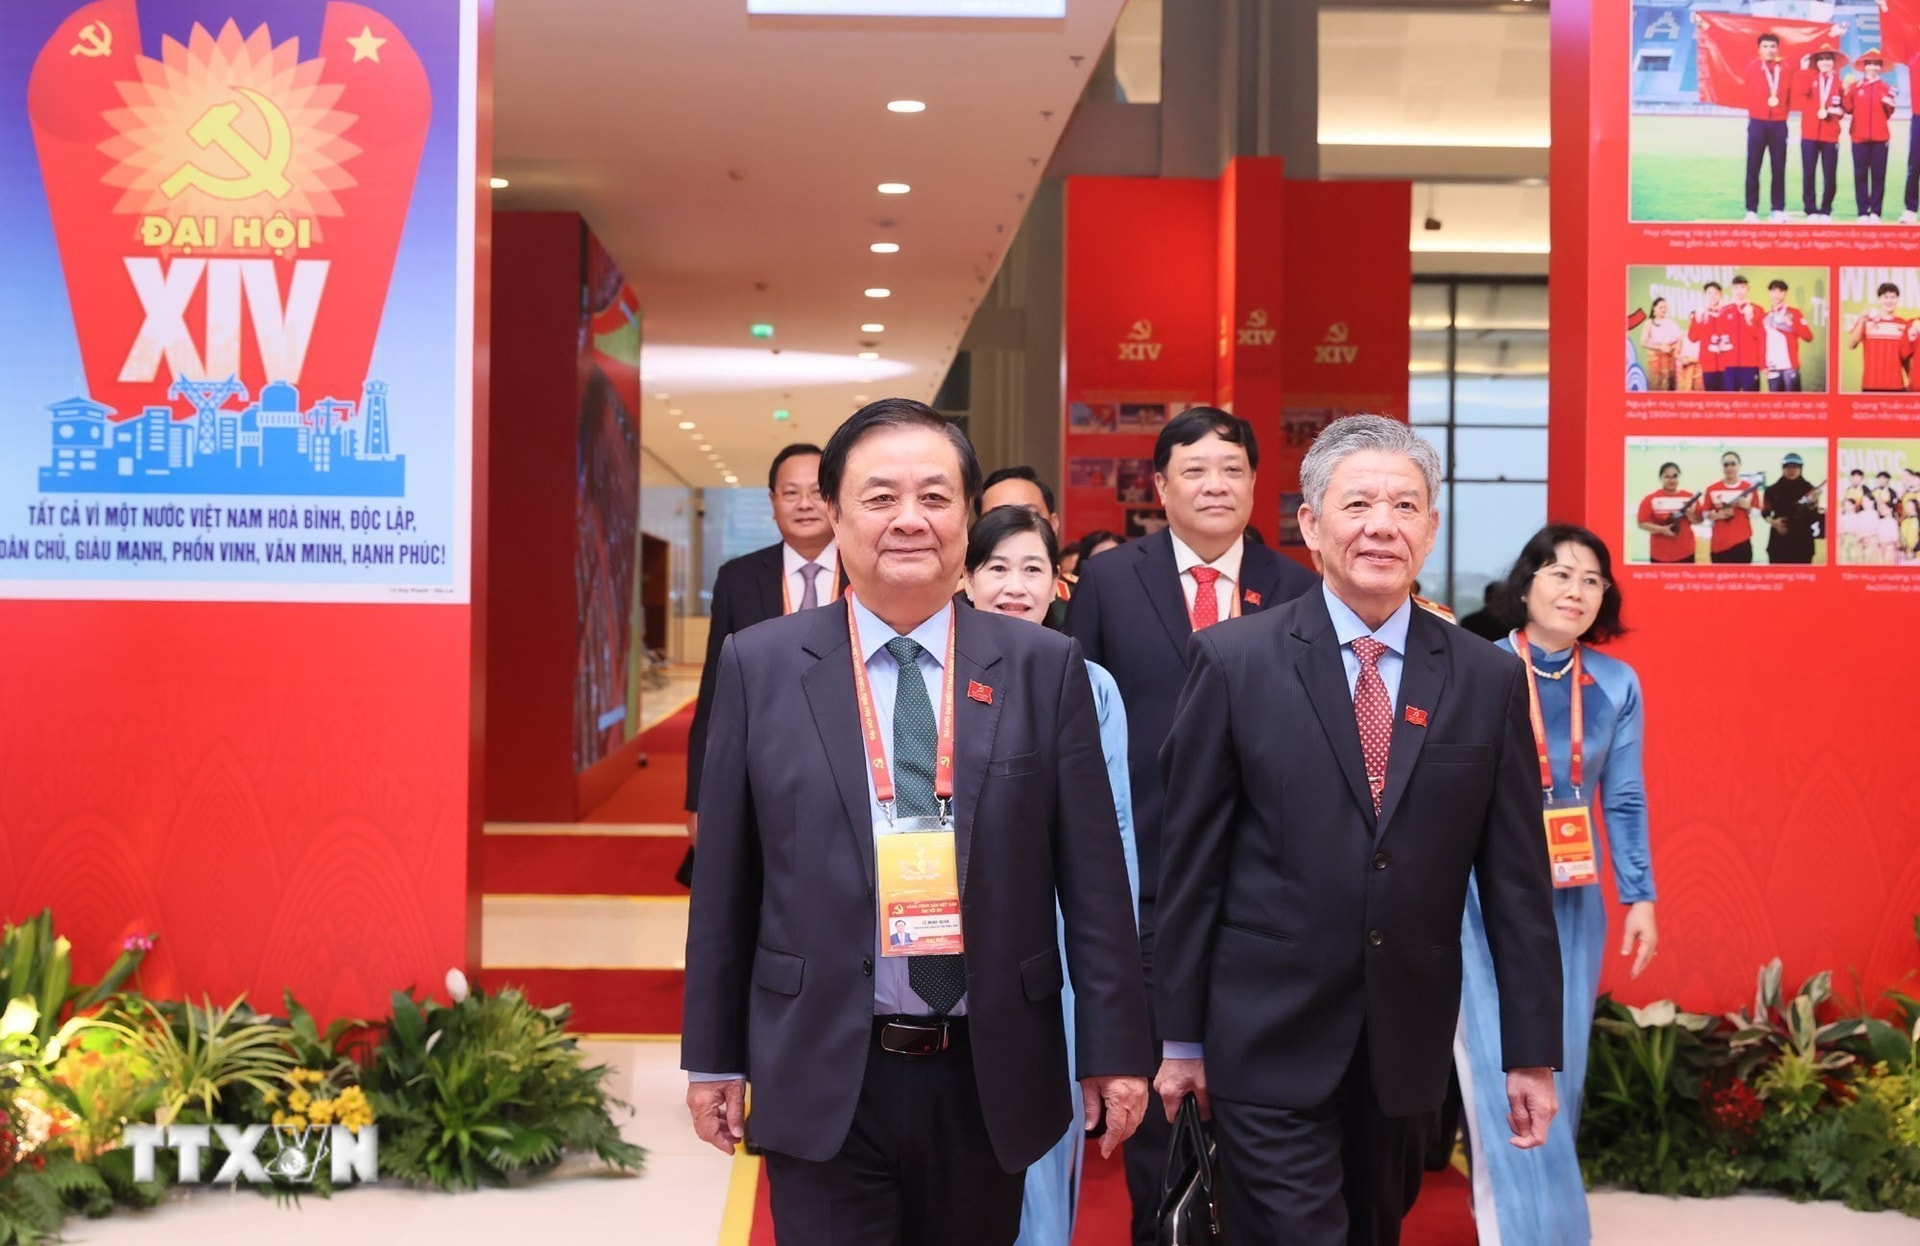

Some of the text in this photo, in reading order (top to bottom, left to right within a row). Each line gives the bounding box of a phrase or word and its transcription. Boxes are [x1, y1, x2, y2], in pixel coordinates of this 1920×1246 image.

[140, 211, 311, 256] ĐẠI HỘI
[117, 257, 331, 386] XIV
[1237, 329, 1276, 345] XIV
[1118, 343, 1163, 361] XIV
[1314, 345, 1359, 363] XIV
[28, 499, 417, 535] TẤT CẢ VÌ MỘT NƯỚC VIỆT NAM HOÀ BÌNH, ĐỘC LẬP,
[35, 533, 70, 562] CHỦ,
[75, 536, 111, 561] GIÀU
[116, 541, 167, 566] MẠNH,
[219, 543, 260, 564] VINH,
[265, 538, 296, 563] VĂN
[301, 544, 347, 566] MINH,
[352, 544, 394, 569] HẠNH
[399, 540, 446, 565] PHÚC!
